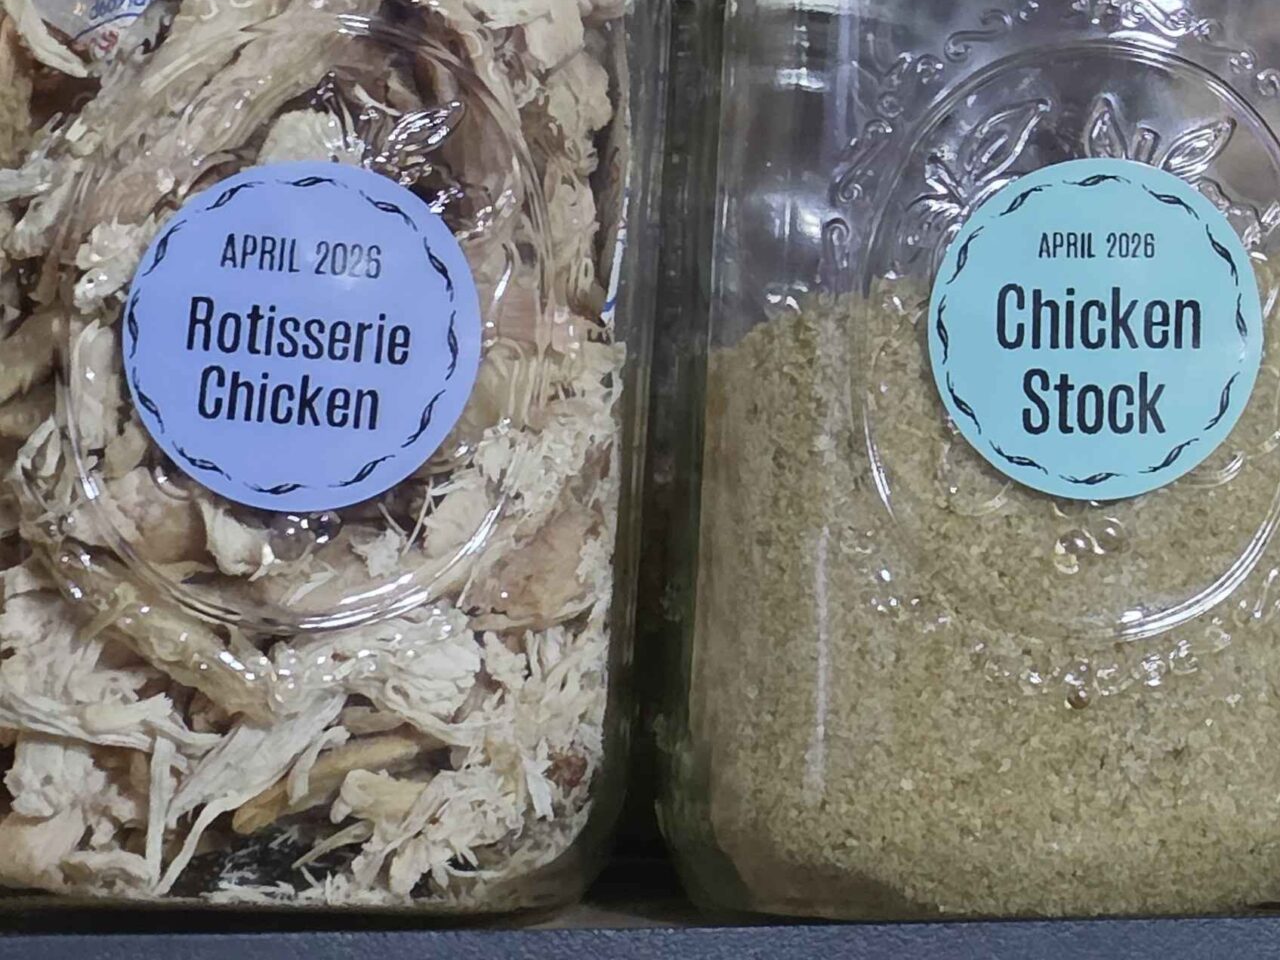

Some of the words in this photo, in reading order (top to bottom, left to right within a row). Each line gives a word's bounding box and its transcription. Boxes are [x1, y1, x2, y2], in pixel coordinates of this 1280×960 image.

[220, 233, 300, 273] APRIL
[314, 240, 382, 280] 2026
[1038, 231, 1096, 259] APRIL
[1106, 232, 1155, 259] 2026
[186, 296, 411, 366] Rotisserie
[996, 283, 1201, 350] Chicken
[197, 364, 380, 430] Chicken
[1022, 368, 1166, 436] Stock
